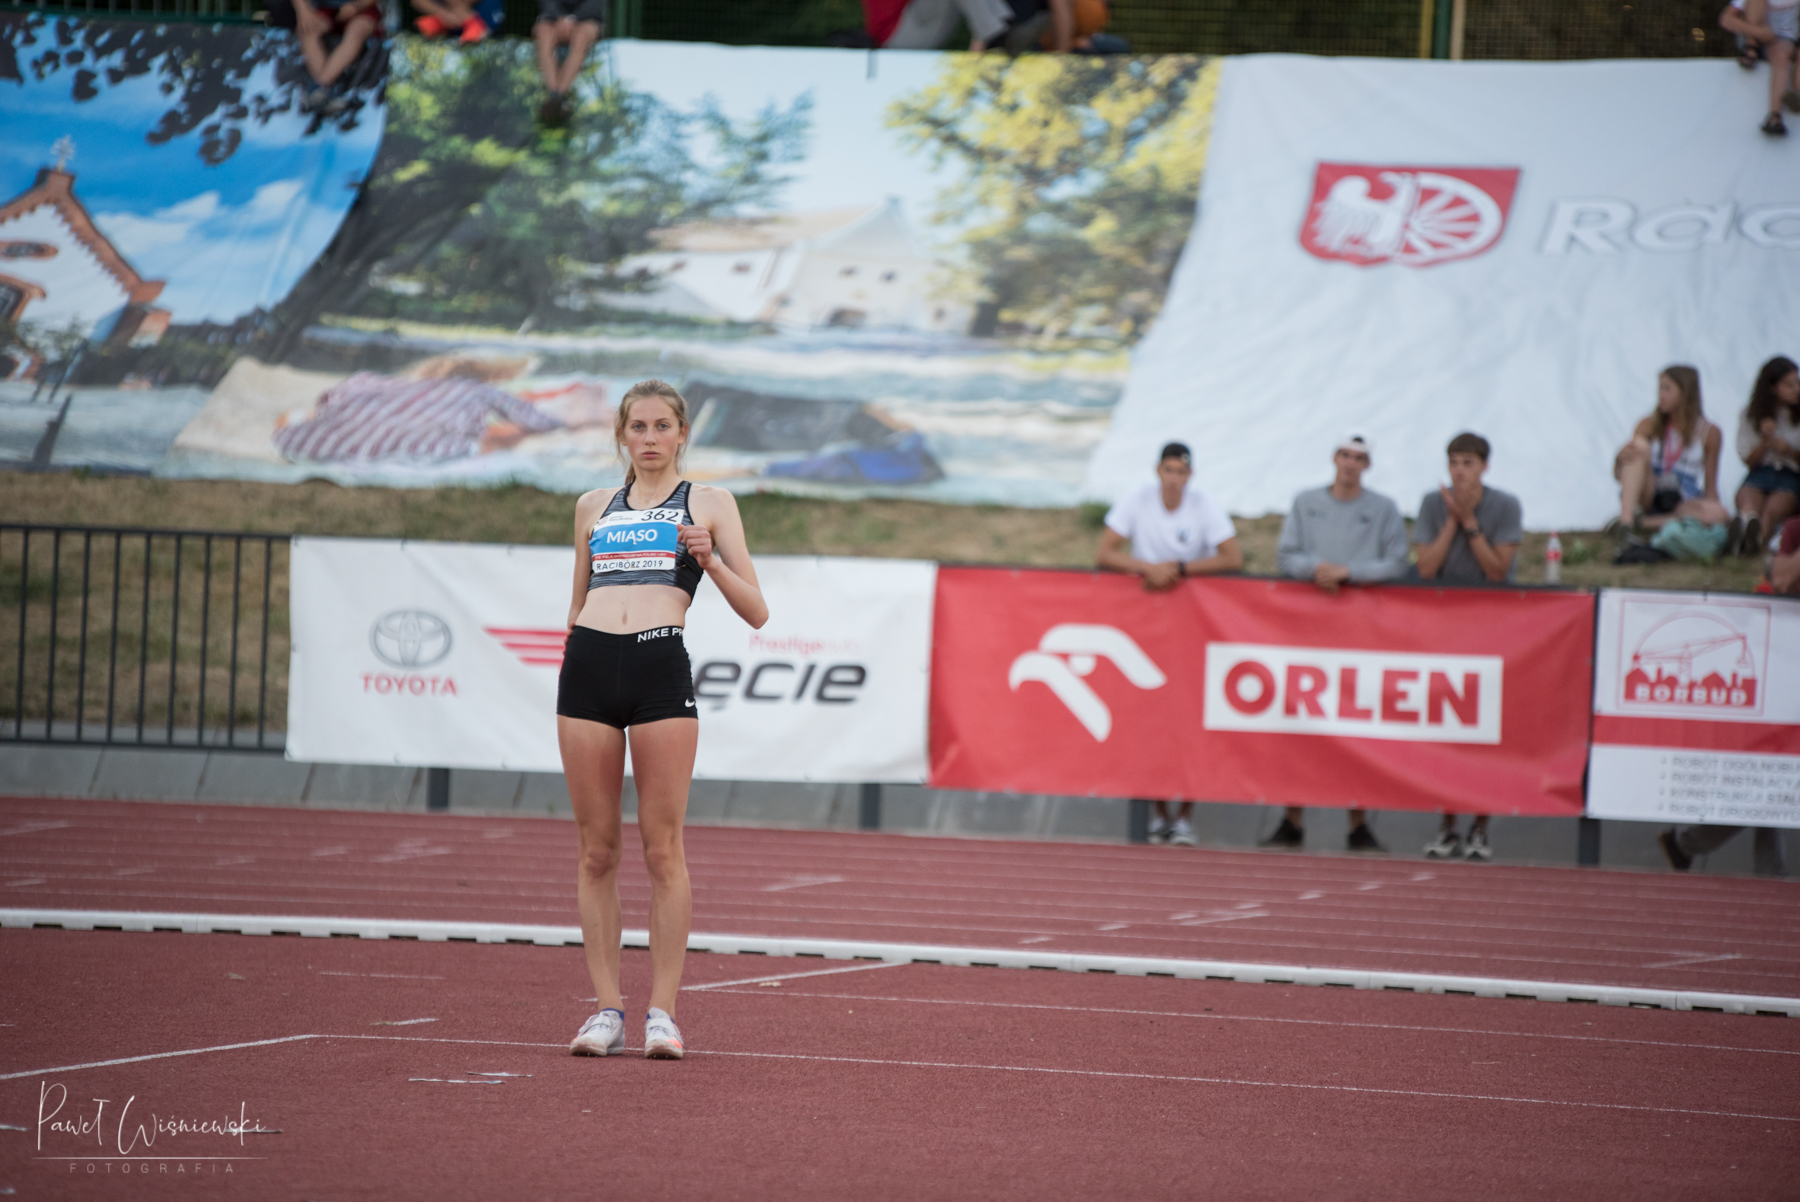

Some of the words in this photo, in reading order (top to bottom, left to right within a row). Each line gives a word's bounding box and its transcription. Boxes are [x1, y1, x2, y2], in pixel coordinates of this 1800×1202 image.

[641, 509, 679, 523] 362
[606, 529, 658, 545] MIĄSO
[596, 560, 641, 571] RACIBÓRZ
[642, 560, 664, 568] 2019
[637, 627, 669, 643] NIKE
[360, 671, 459, 698] TOYOTA
[1222, 659, 1482, 729] ORLEN
[1635, 683, 1748, 706] BORBUD
